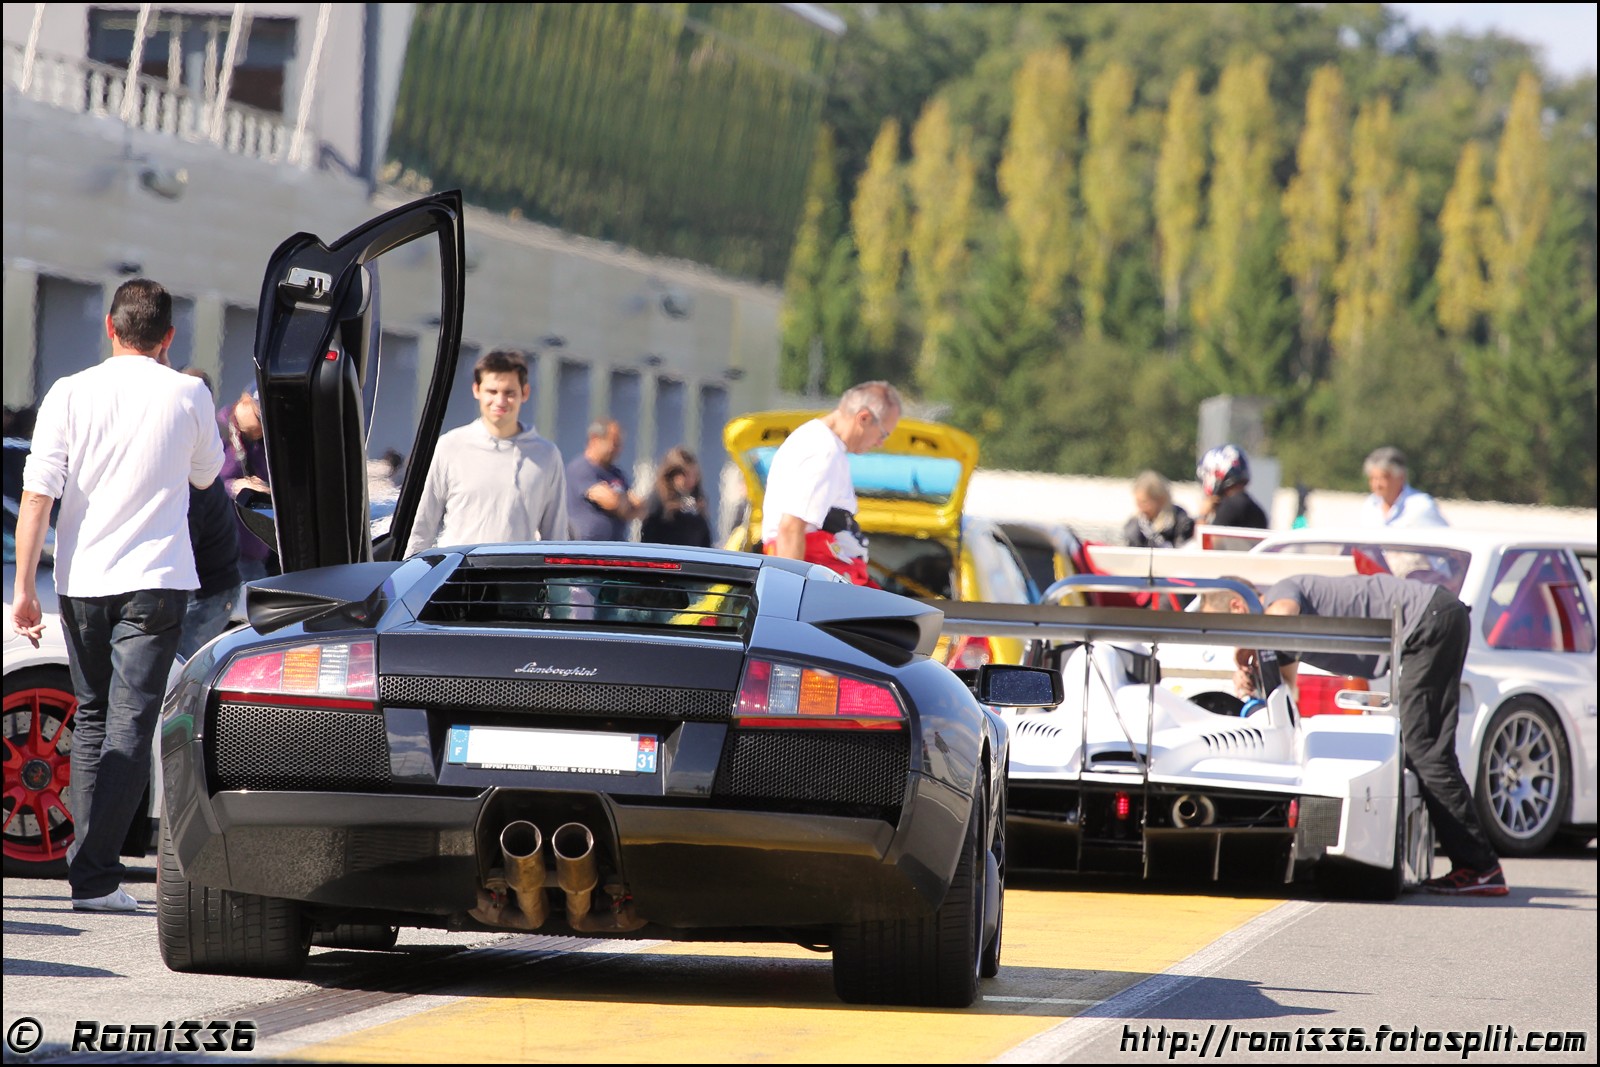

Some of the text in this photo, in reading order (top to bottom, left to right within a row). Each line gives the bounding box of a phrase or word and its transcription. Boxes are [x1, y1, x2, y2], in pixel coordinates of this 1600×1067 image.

[514, 662, 598, 676] Lamborghini
[455, 747, 462, 756] F
[637, 754, 654, 769] 31
